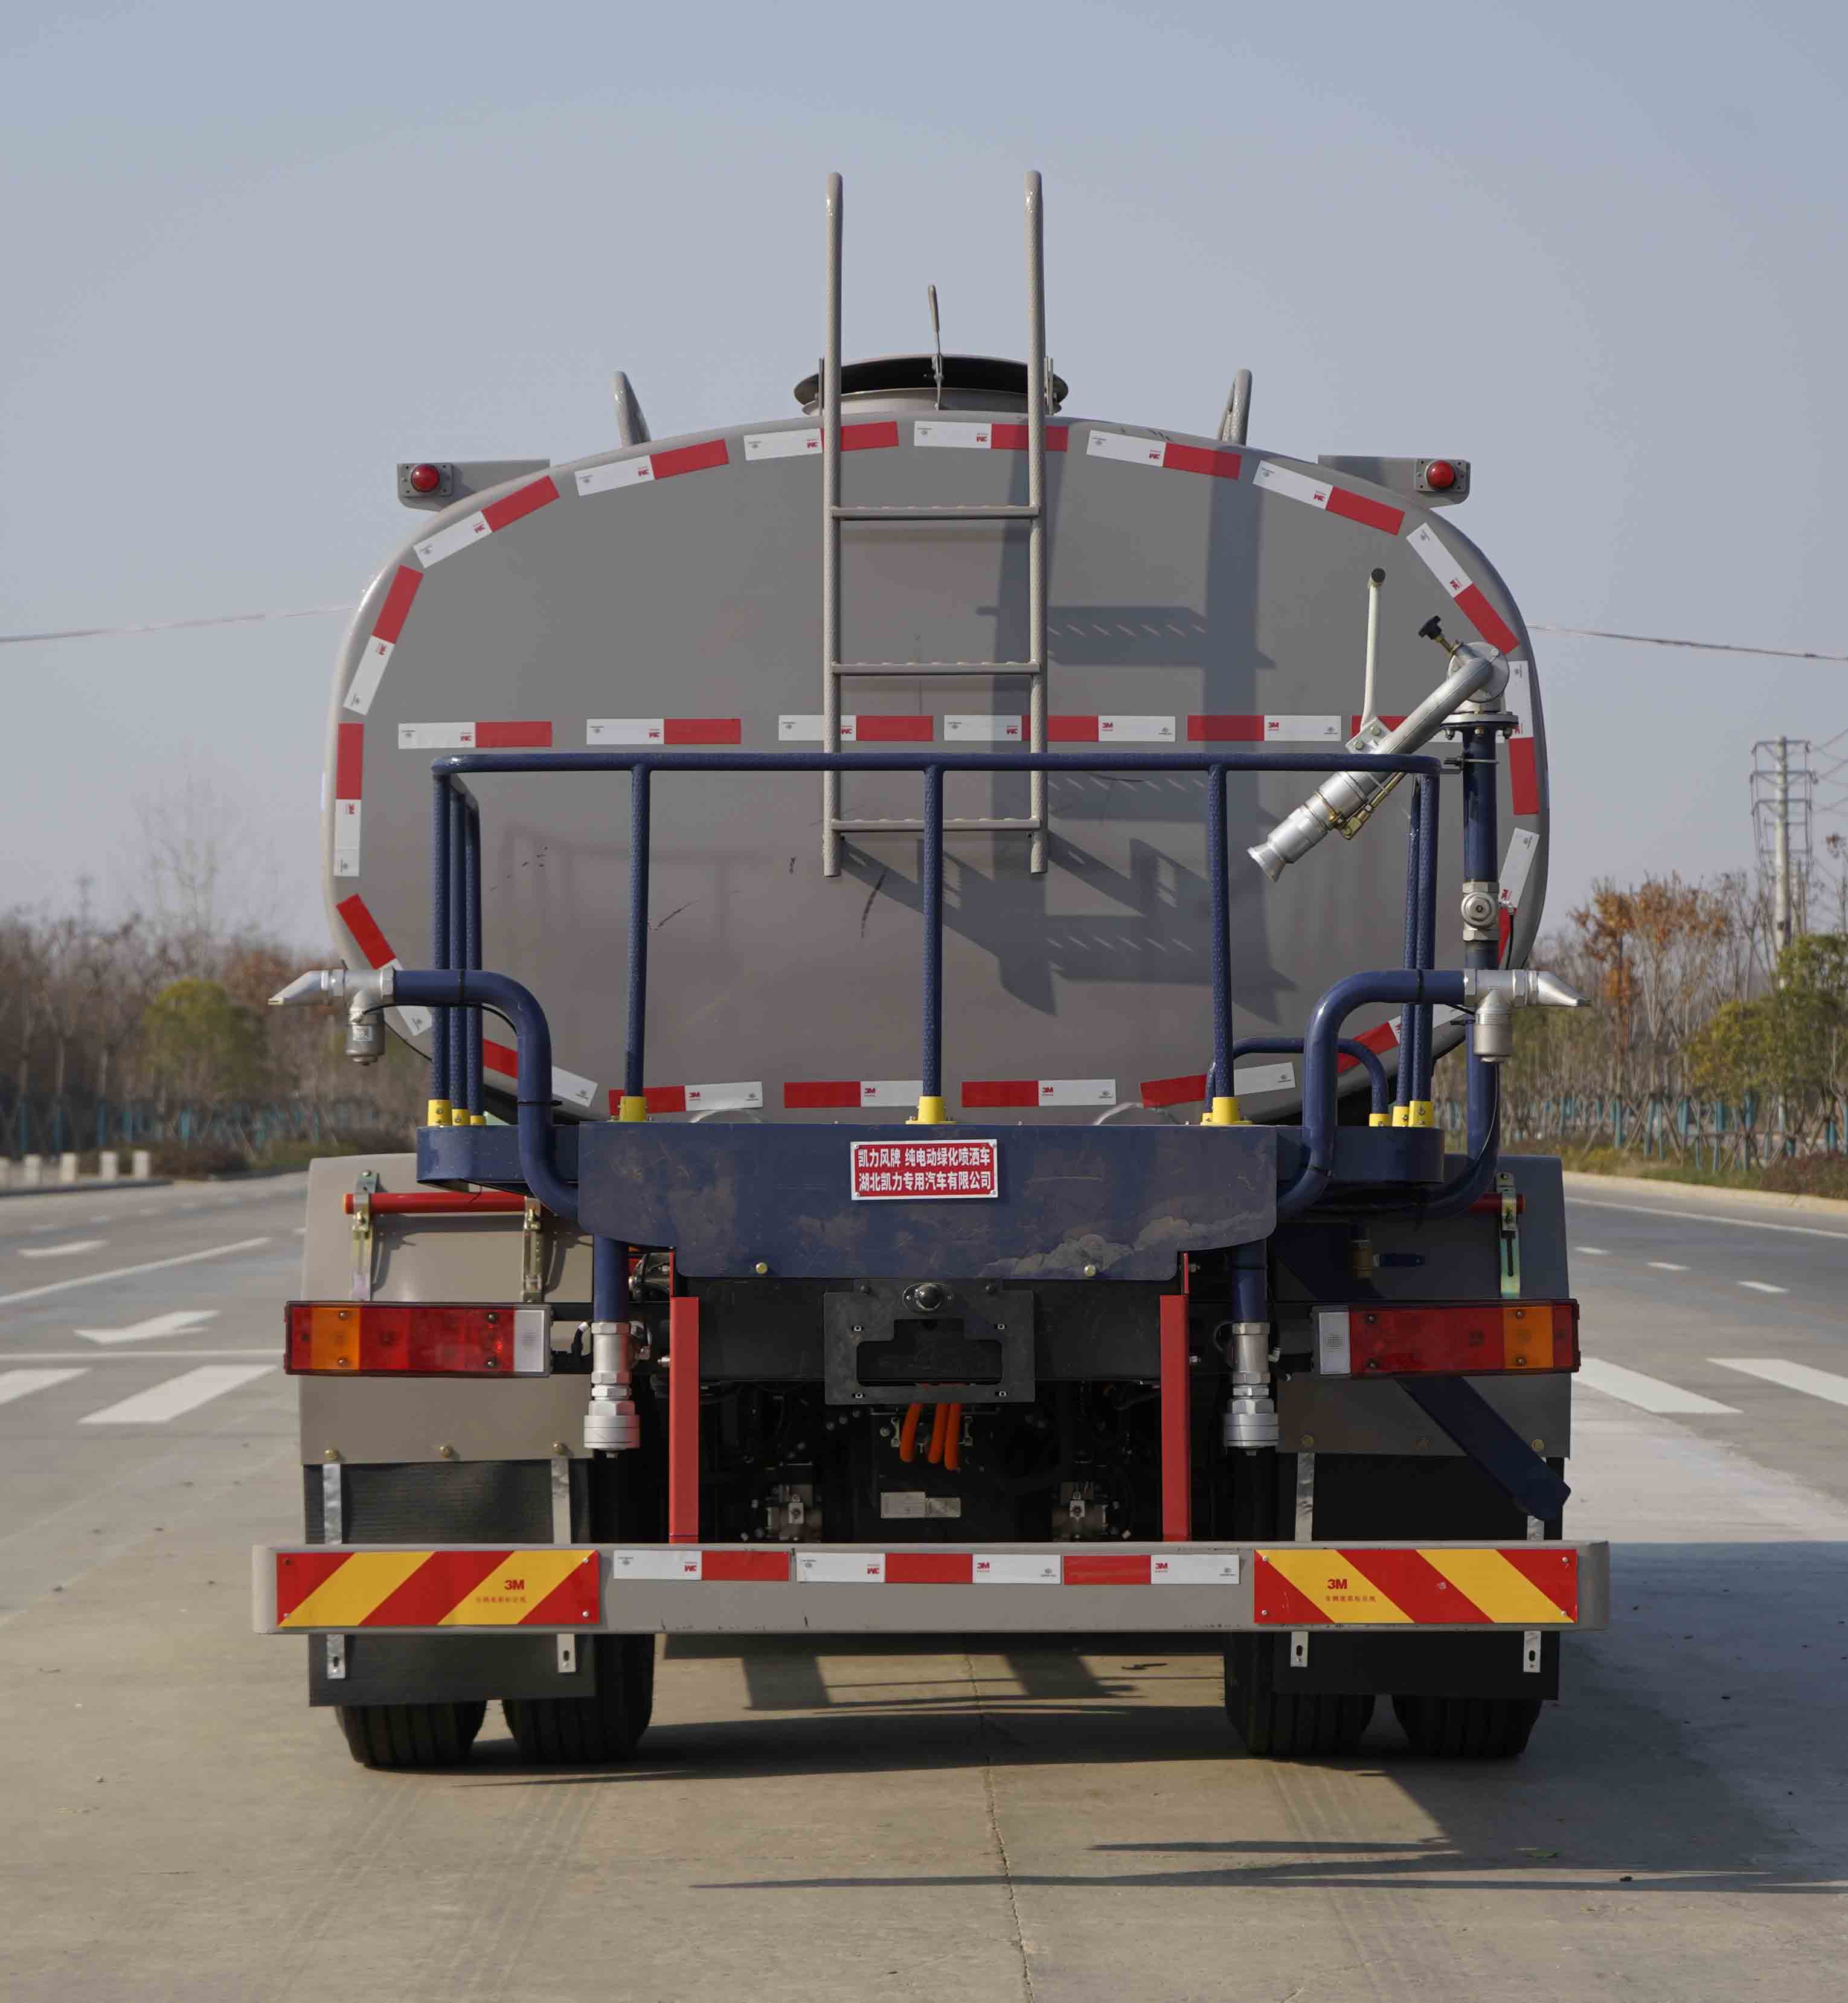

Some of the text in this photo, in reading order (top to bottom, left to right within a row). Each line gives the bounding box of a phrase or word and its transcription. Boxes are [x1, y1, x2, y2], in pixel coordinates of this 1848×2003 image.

[858, 1147, 990, 1167] 凯力风牌 纯电动绿化喷洒车
[859, 1171, 991, 1191] 湖北凯力专用汽车有限公司
[504, 1580, 524, 1590] 3M
[1327, 1578, 1347, 1589] 3M
